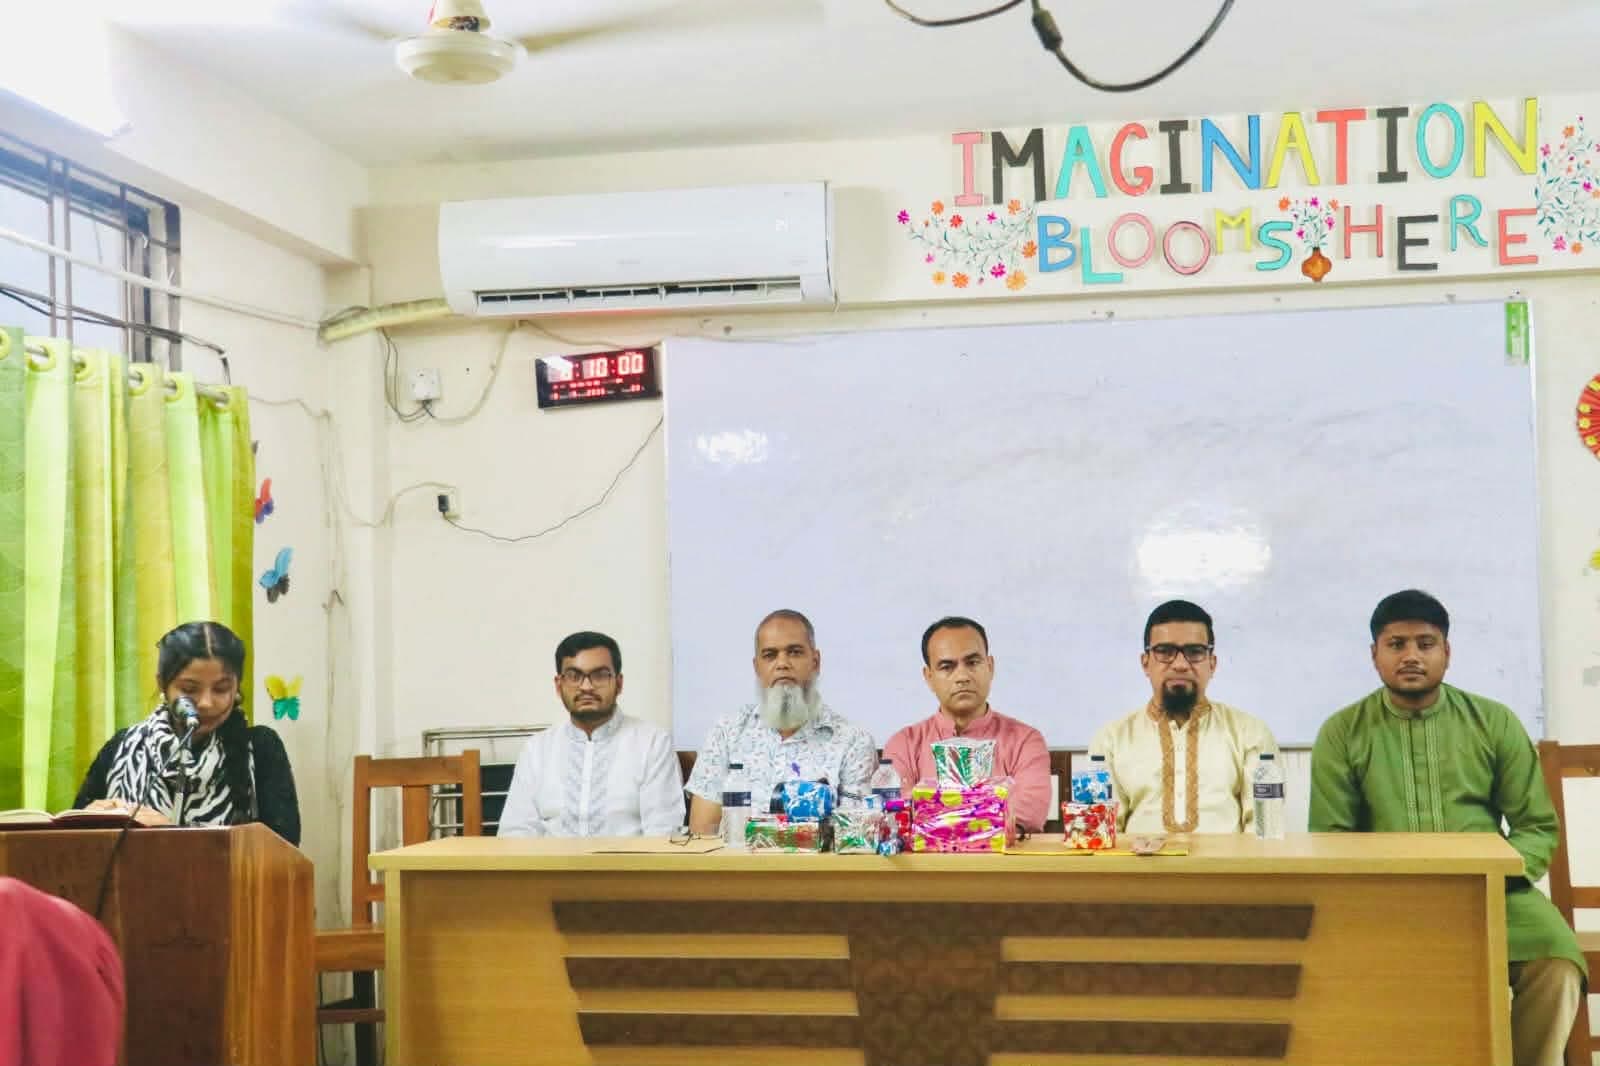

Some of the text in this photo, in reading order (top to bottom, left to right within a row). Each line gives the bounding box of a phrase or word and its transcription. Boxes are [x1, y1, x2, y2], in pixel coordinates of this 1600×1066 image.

[952, 98, 1538, 206] IMAGINATION
[1036, 195, 1538, 284] BLOOMS HERE
